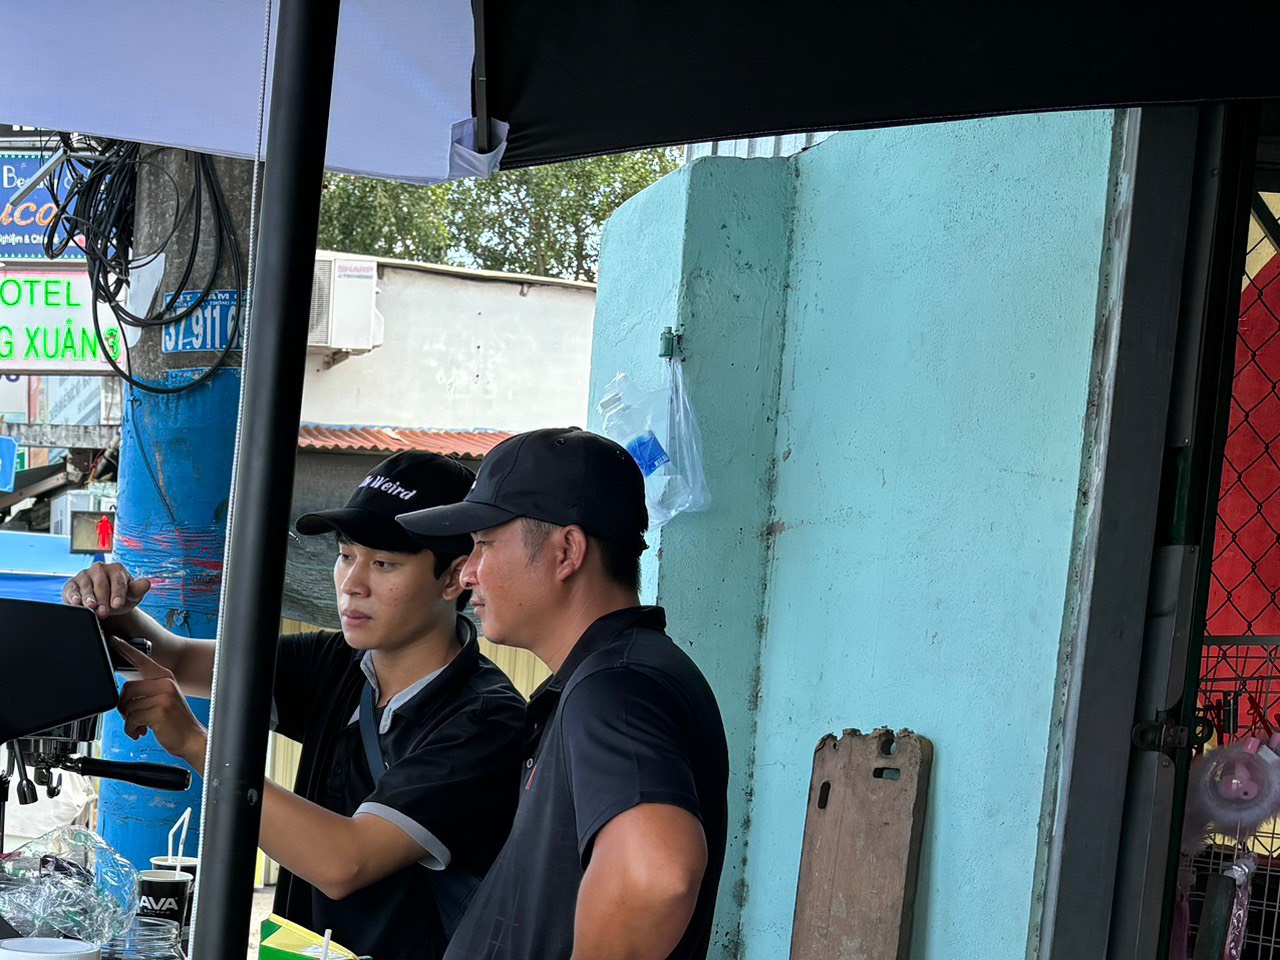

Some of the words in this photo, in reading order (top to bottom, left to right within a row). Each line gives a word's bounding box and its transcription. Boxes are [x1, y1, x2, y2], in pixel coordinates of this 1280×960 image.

[24, 318, 98, 360] XUÂN
[104, 327, 120, 361] 3
[370, 475, 417, 500] Weird
[140, 895, 179, 910] AVA
